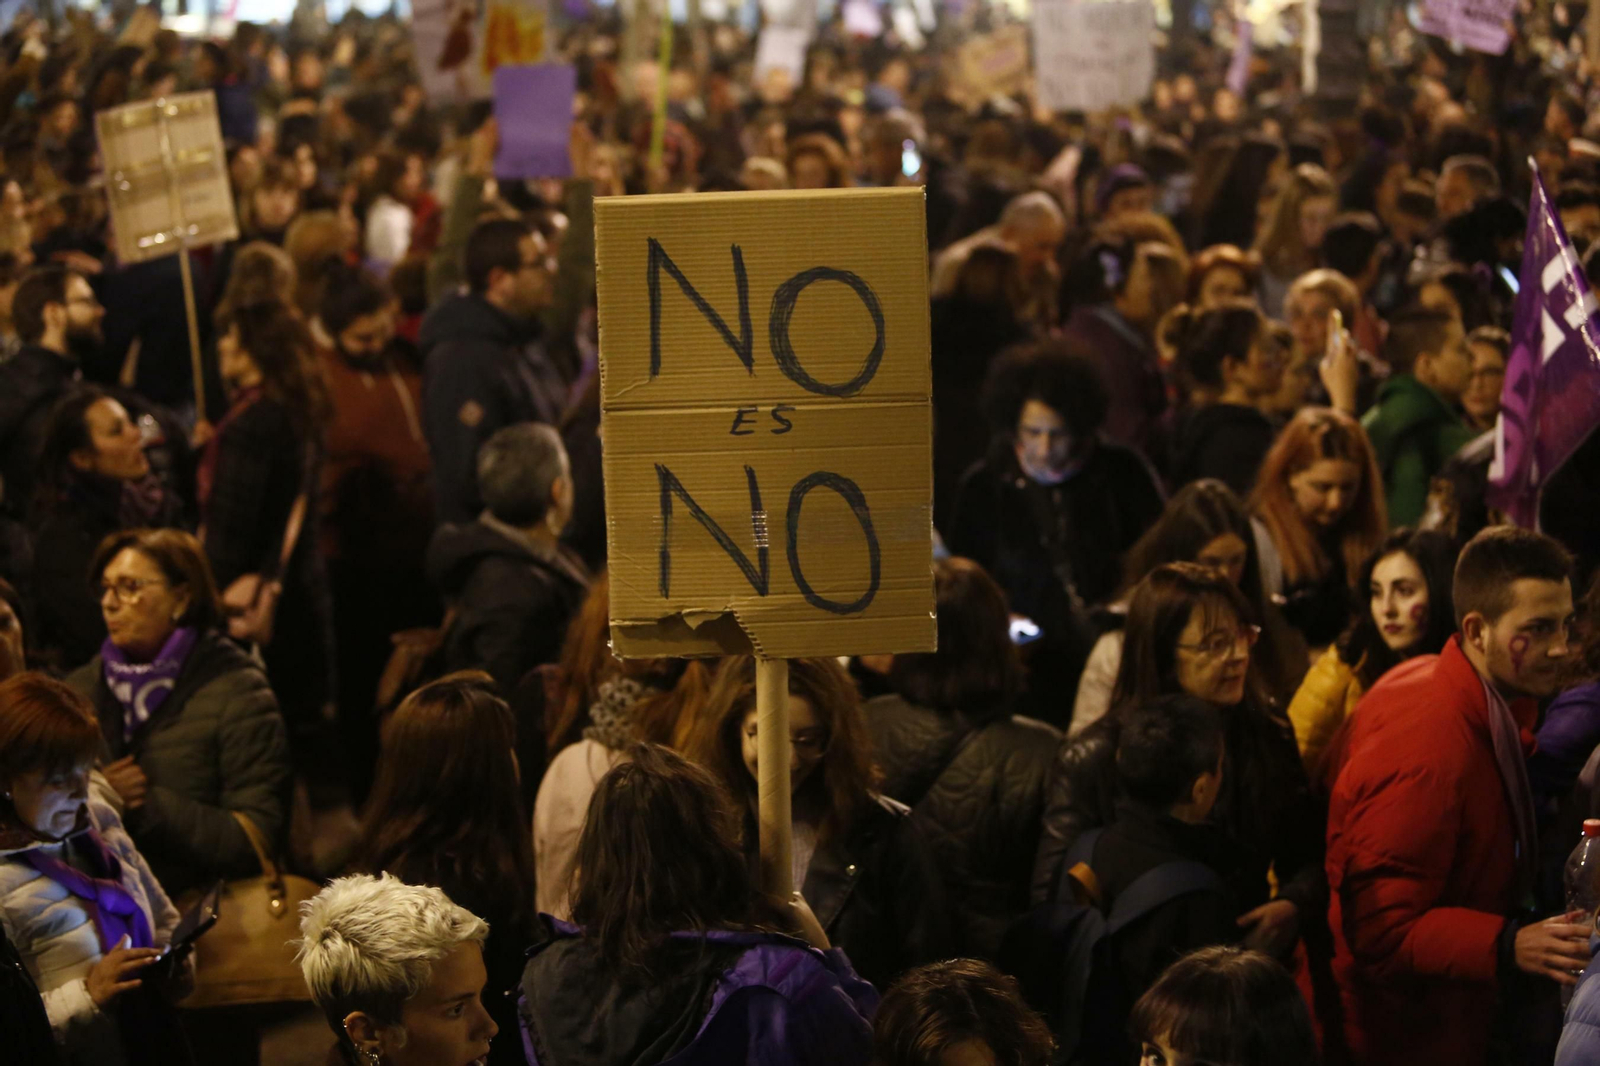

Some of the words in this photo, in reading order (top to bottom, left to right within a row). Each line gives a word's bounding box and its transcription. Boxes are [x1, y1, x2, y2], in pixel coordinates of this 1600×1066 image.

[647, 237, 885, 396] NO
[730, 406, 795, 434] ES
[655, 463, 880, 615] NO
